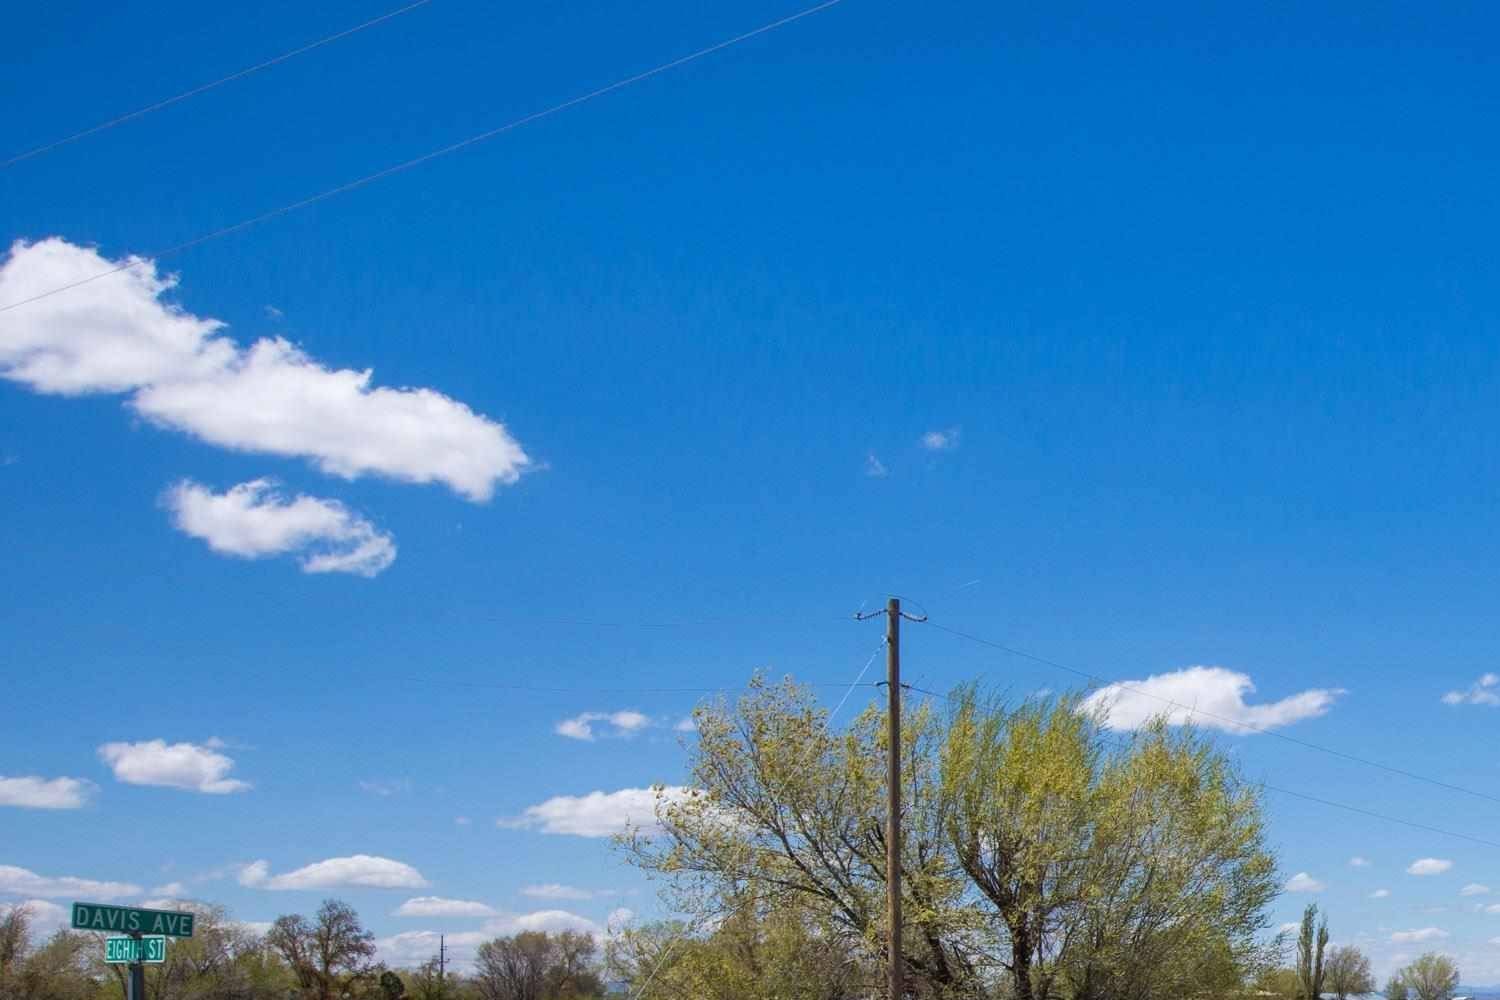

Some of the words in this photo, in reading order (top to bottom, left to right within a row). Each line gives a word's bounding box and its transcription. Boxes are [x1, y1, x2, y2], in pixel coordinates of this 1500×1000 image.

[77, 907, 140, 930] DAVIS
[152, 914, 191, 935] AVE
[149, 940, 162, 958] ST
